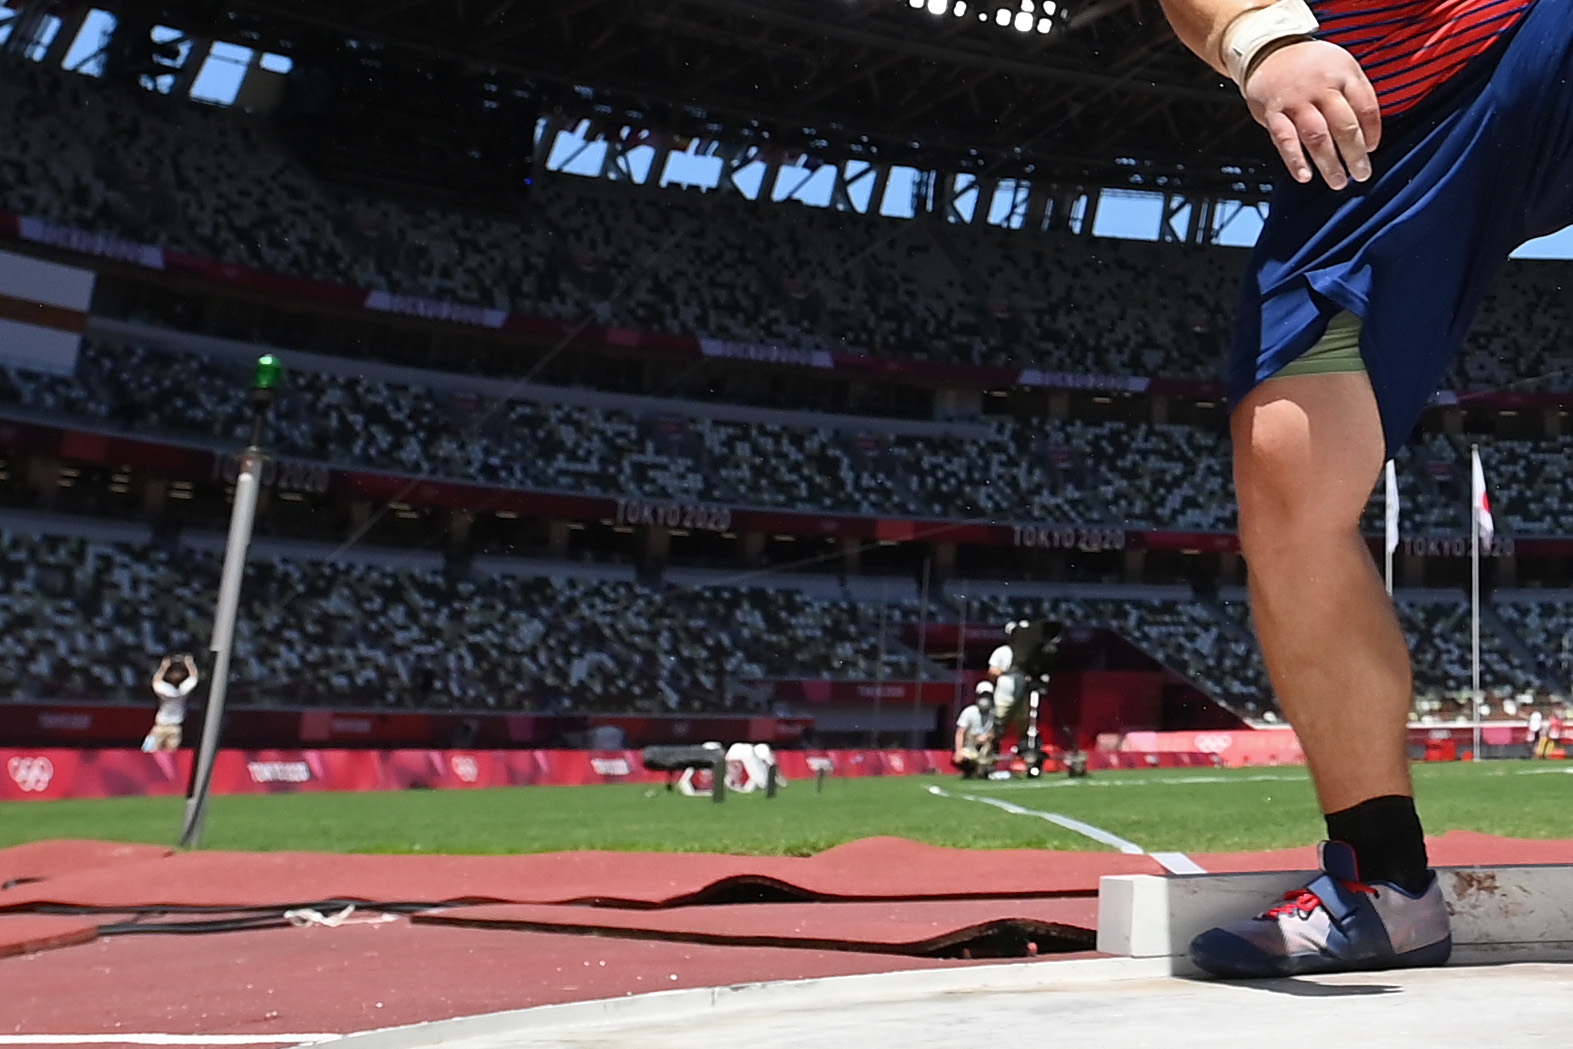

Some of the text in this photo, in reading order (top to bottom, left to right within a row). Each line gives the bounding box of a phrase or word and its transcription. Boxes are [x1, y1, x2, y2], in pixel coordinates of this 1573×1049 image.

[615, 500, 732, 532] TOKYO 2020
[1013, 526, 1125, 550] TOKYO 2020
[1402, 537, 1465, 557] TOKYO
